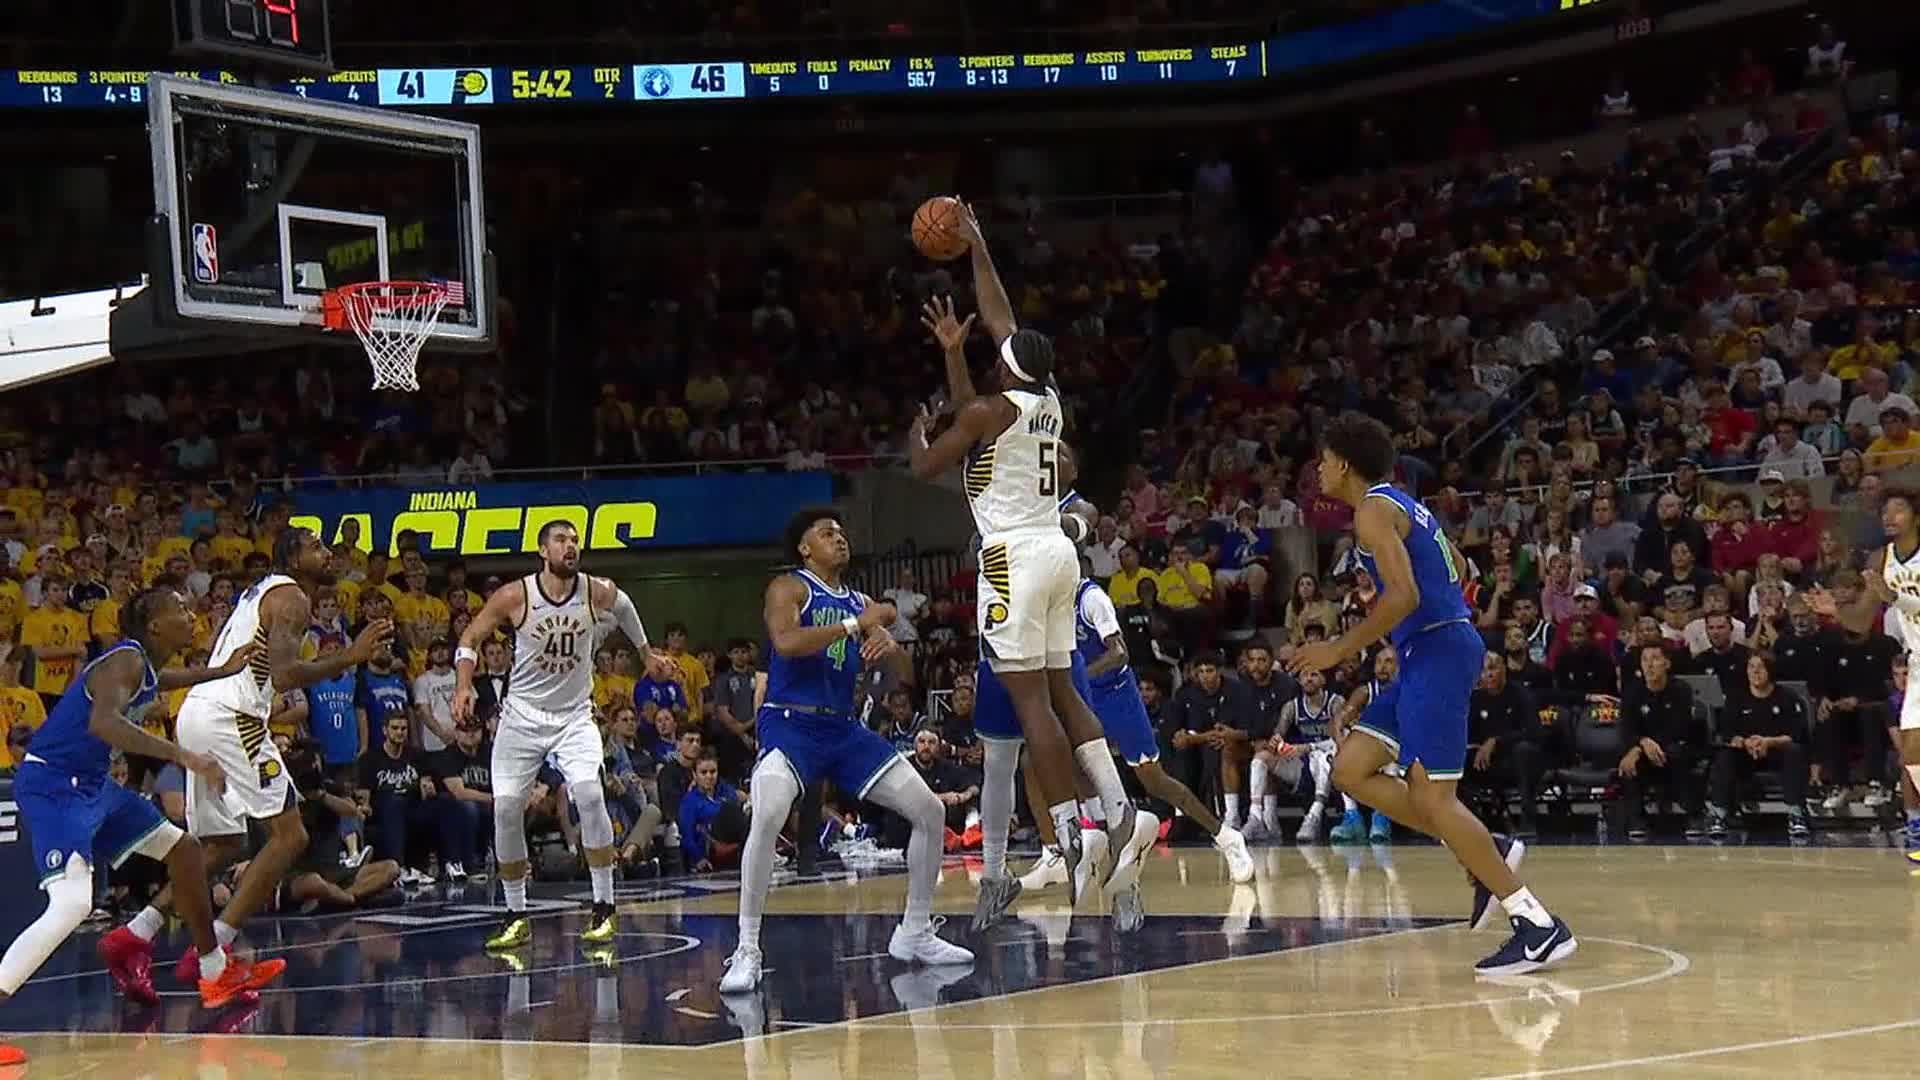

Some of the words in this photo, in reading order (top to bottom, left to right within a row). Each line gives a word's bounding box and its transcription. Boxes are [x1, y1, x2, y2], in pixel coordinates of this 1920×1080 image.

[1023, 53, 1075, 66] REBOUNDS
[1086, 51, 1126, 64] ASSISTS
[1136, 49, 1193, 62] TURNOVERS
[1211, 45, 1247, 59] STEALS
[750, 62, 797, 75] TIMEOUTS
[807, 60, 838, 73] FOULS
[849, 59, 891, 72] PENALTY
[959, 57, 967, 69] 3
[968, 55, 1015, 68] POINTERS
[1226, 60, 1237, 77] 7
[18, 71, 78, 84] REBOUNDS
[89, 71, 98, 84] 3
[594, 68, 620, 83] QTR
[691, 65, 725, 92] 46
[907, 71, 936, 87] 56.7
[1043, 67, 1060, 83] 17
[1101, 65, 1118, 81] 10
[1160, 63, 1173, 79] 11
[397, 71, 424, 98] 41
[512, 70, 572, 98] 5:42
[770, 76, 780, 92] 5
[818, 75, 829, 90] 0
[43, 86, 62, 103] 13
[347, 85, 360, 101] 4
[605, 84, 614, 98] 2
[1039, 442, 1055, 496] 5
[409, 491, 477, 512] INDIANA
[543, 632, 575, 658] 40
[826, 632, 849, 673] 4
